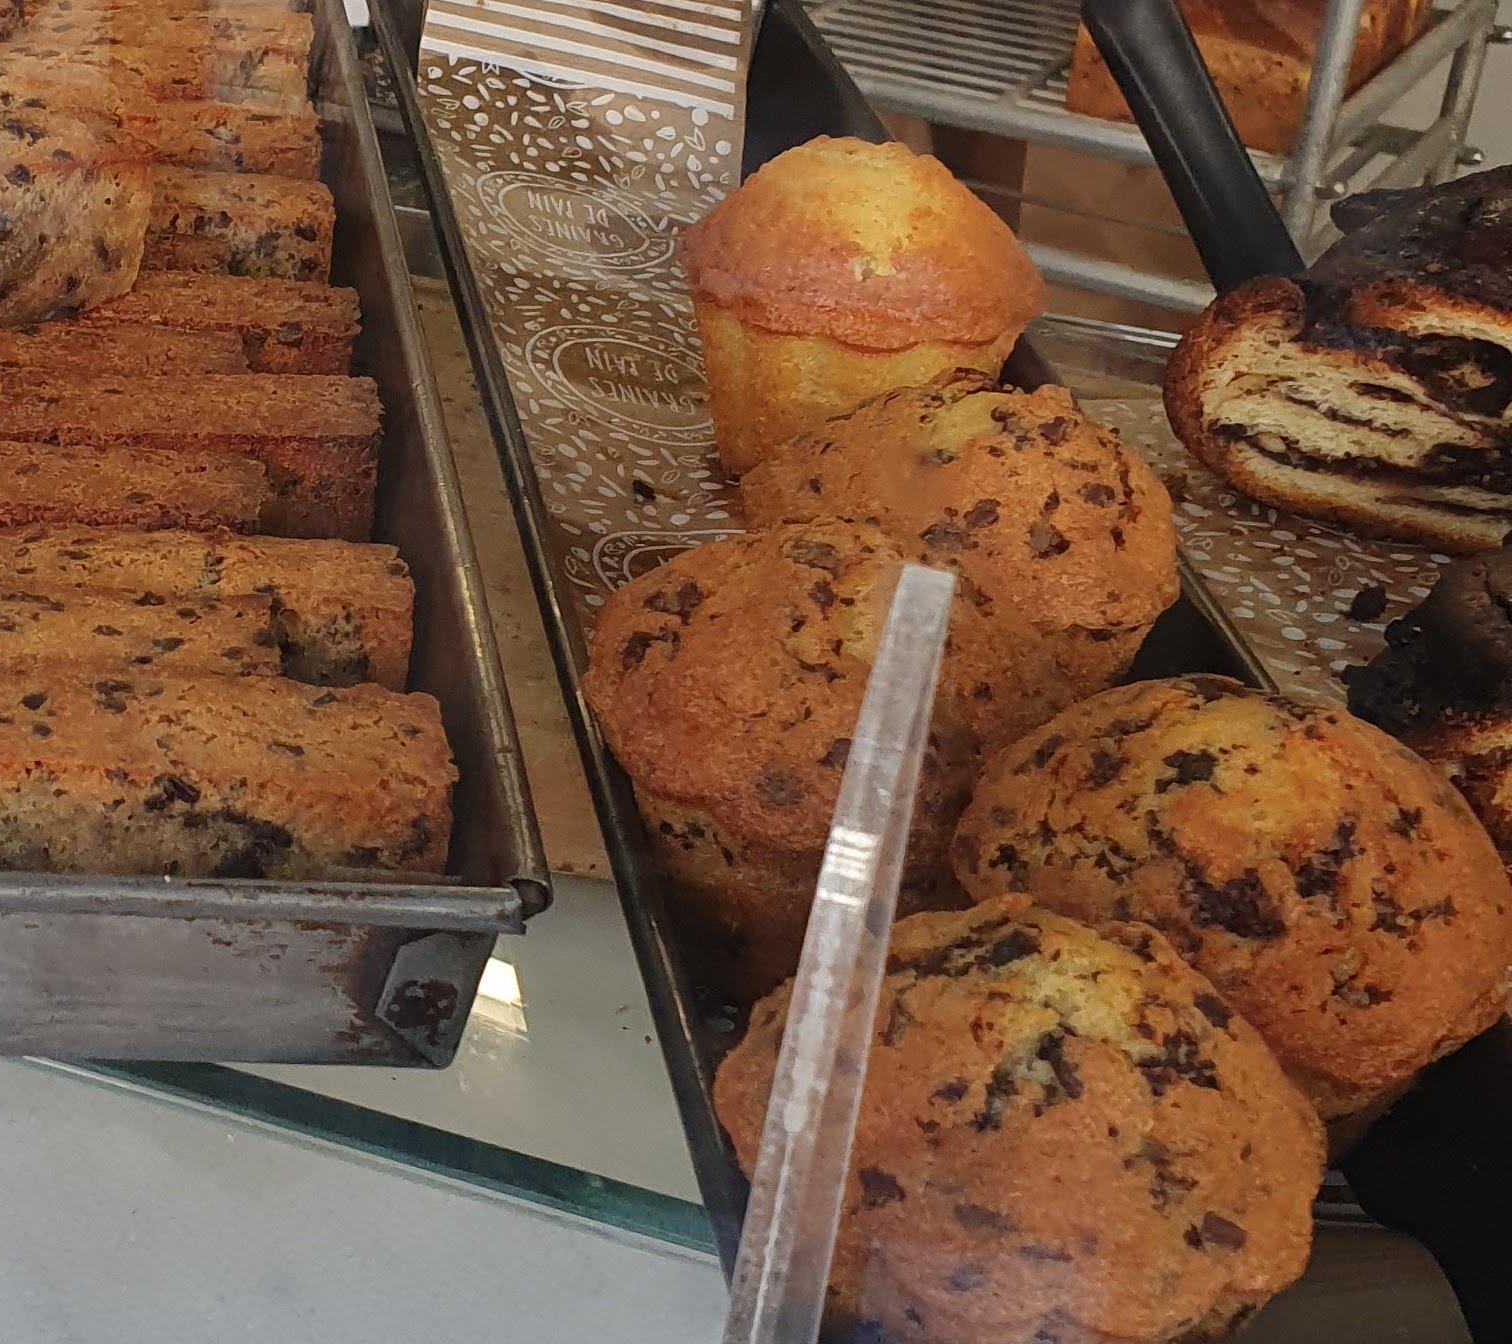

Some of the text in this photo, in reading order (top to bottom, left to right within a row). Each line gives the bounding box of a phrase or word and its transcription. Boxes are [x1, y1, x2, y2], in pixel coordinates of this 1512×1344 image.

[526, 189, 609, 228] DE PAIN
[584, 345, 639, 377] PAIN
